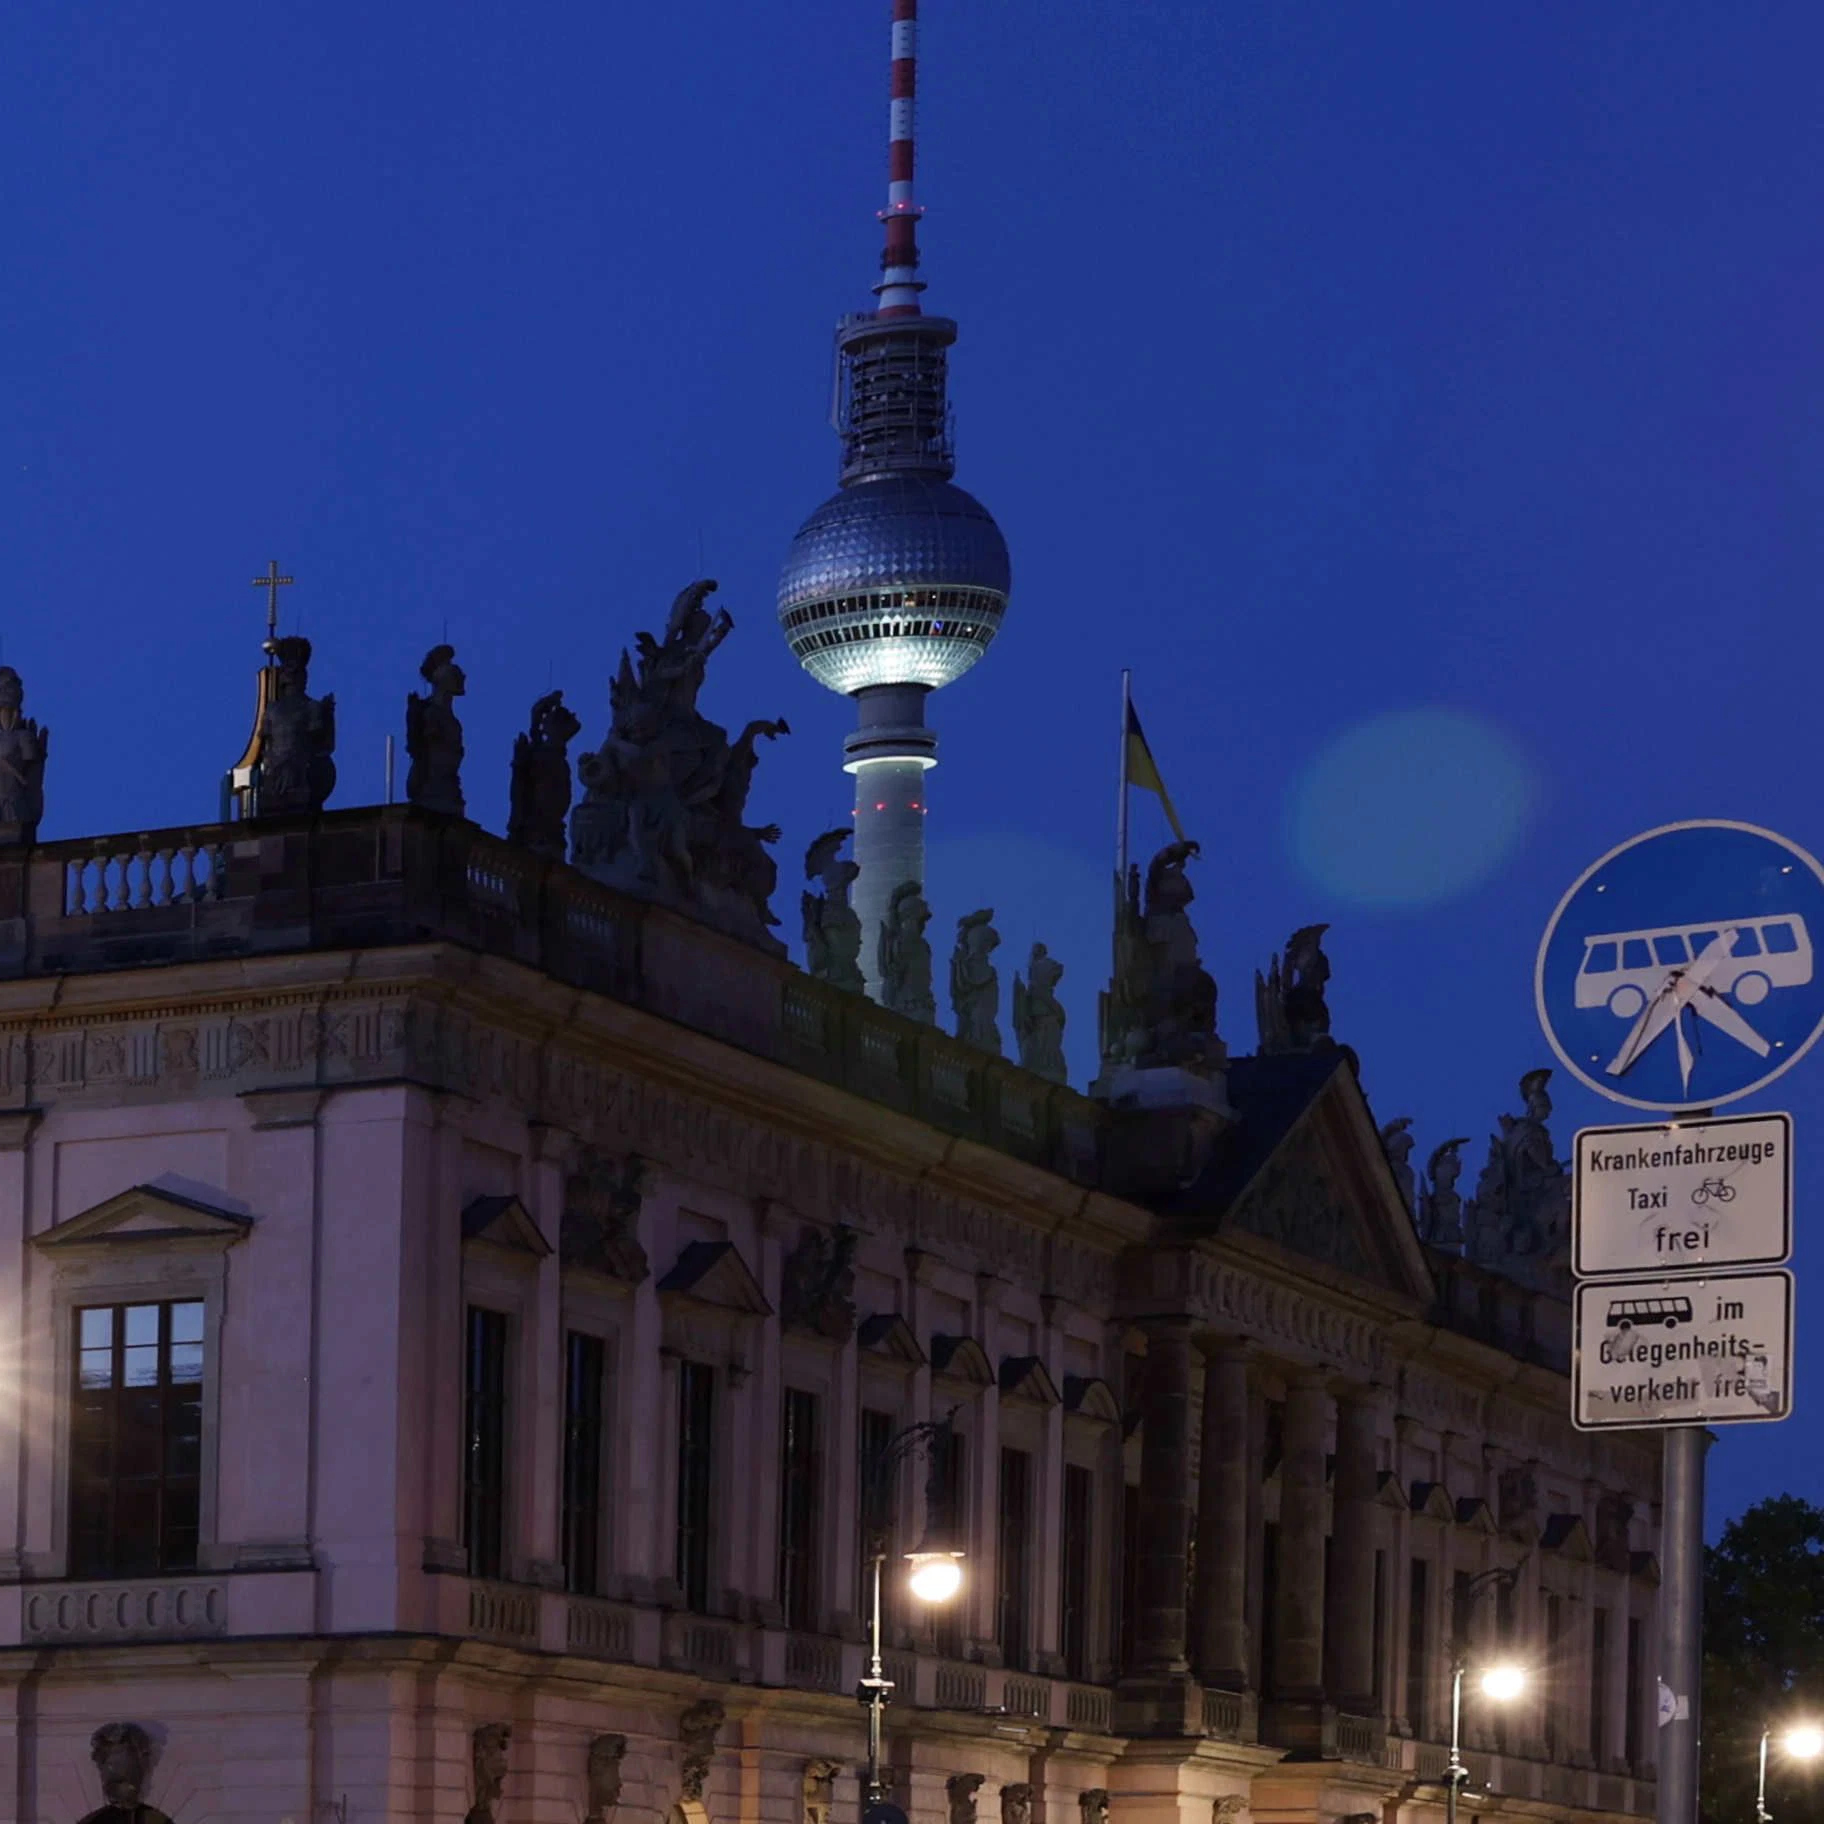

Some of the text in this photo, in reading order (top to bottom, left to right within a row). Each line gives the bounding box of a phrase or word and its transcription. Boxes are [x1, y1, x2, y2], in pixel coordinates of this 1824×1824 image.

[1590, 1141, 1775, 1173] Krankenfahrzeuge
[1627, 1186, 1668, 1210] Taxi
[1655, 1223, 1709, 1252] frei
[1716, 1296, 1744, 1321] im
[1610, 1373, 1748, 1404] verkehr fre
